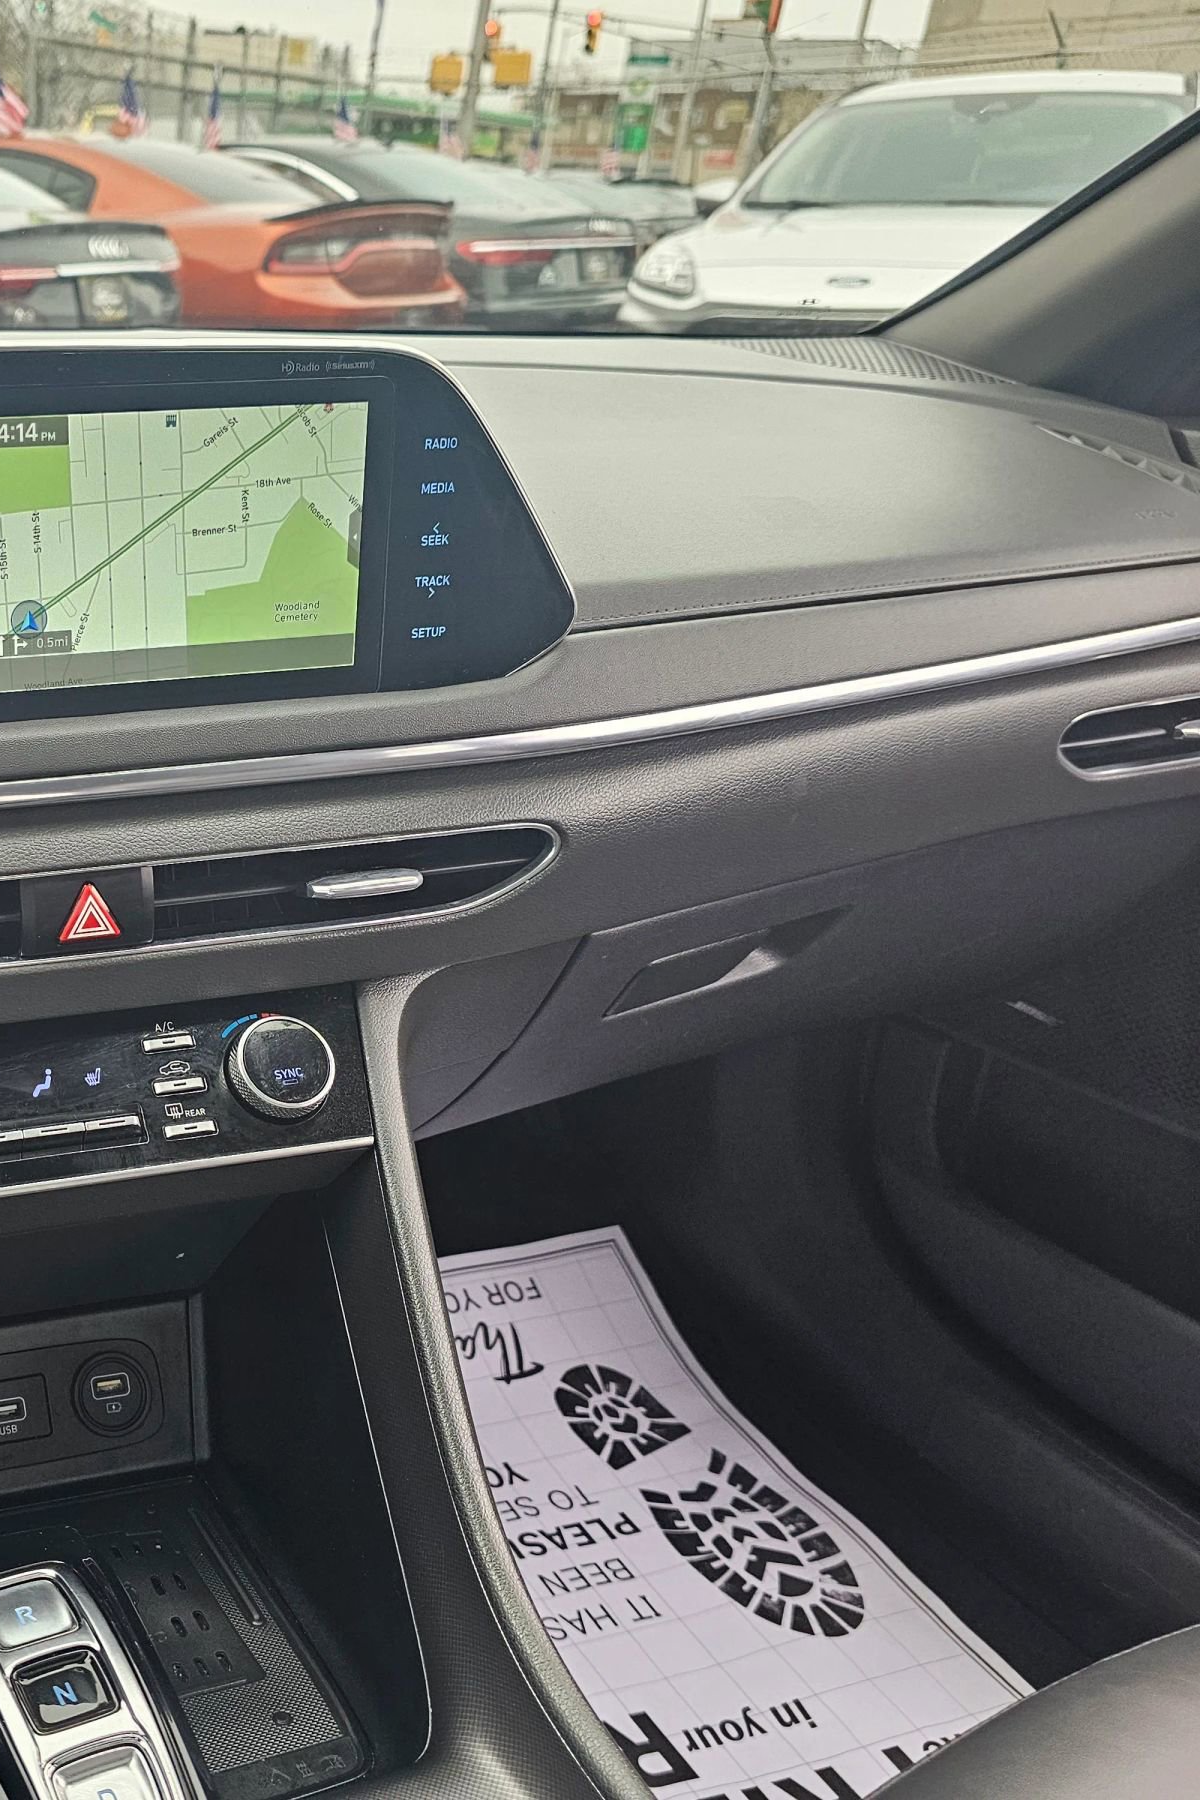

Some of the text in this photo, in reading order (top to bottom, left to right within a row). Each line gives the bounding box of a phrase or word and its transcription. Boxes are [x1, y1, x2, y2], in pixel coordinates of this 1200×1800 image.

[296, 362, 320, 372] Radio
[40, 431, 56, 442] PM
[203, 416, 239, 448] Gareis St
[308, 424, 318, 438] St
[424, 437, 458, 450] RADIO
[255, 477, 292, 488] 18th Ave
[421, 481, 455, 495] MEDIA
[241, 488, 250, 524] Kent St
[307, 502, 333, 529] Rose St
[31, 512, 42, 554] S 14th St
[192, 524, 237, 537] Brenner St
[420, 533, 449, 547] SEEK
[0, 550, 8, 571] 15th
[0, 571, 9, 580] S
[415, 575, 450, 588] TRACK
[274, 600, 320, 612] Woodland
[274, 612, 318, 623] Cemetery
[72, 613, 90, 652] Pierce St
[411, 625, 447, 639] SETUP
[36, 637, 69, 649] 0.5mi
[155, 1021, 175, 1033] A/C
[274, 1067, 303, 1080] SYNC
[184, 1107, 207, 1118] REAR
[482, 1277, 542, 1306] FOR
[0, 1424, 18, 1436] USB
[547, 1484, 600, 1511] TO
[537, 1557, 635, 1597] BEEN
[13, 1604, 38, 1627] R
[542, 1594, 662, 1641] IT HAS
[51, 1680, 78, 1707] N
[768, 1698, 818, 1729] in
[681, 1706, 768, 1752] your
